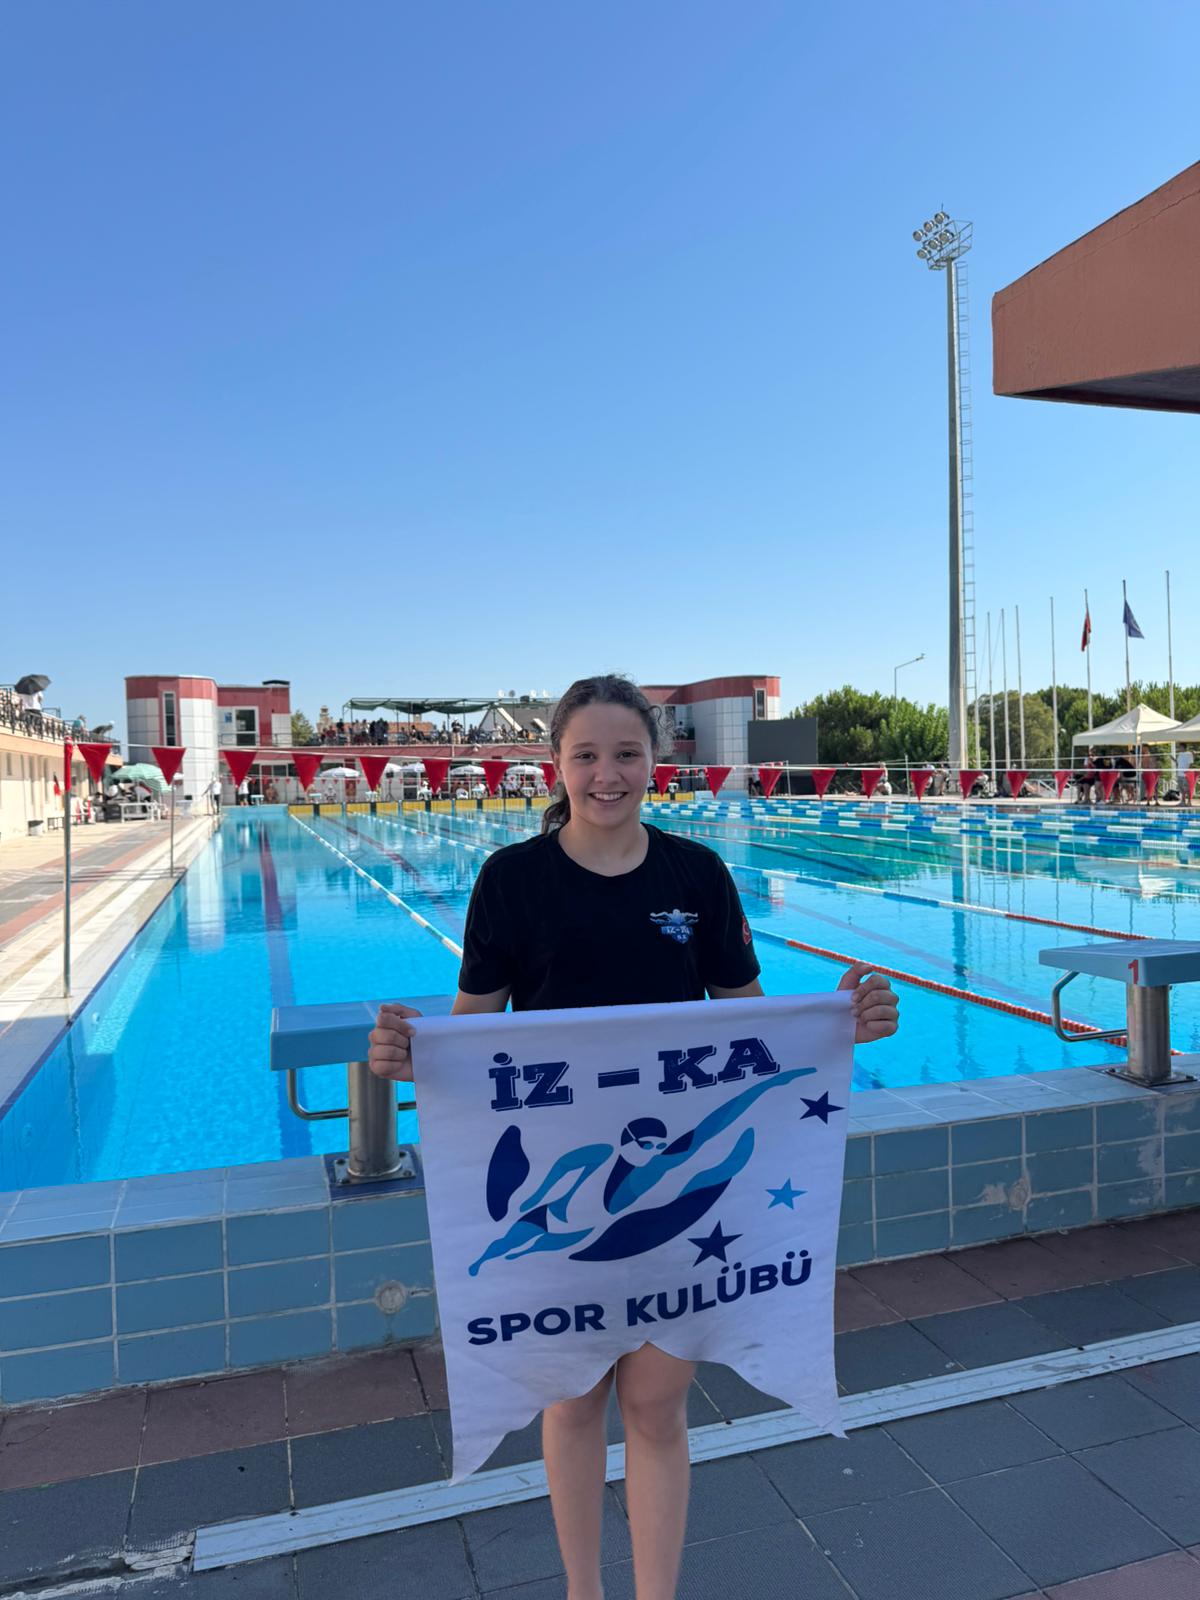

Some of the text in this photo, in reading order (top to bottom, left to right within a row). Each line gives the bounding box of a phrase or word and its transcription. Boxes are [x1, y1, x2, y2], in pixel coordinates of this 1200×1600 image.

[1128, 958, 1139, 985] 1
[487, 1052, 574, 1112] İZ
[658, 1037, 781, 1094] KA
[467, 1250, 812, 1346] SPOR KULÜBÜ
